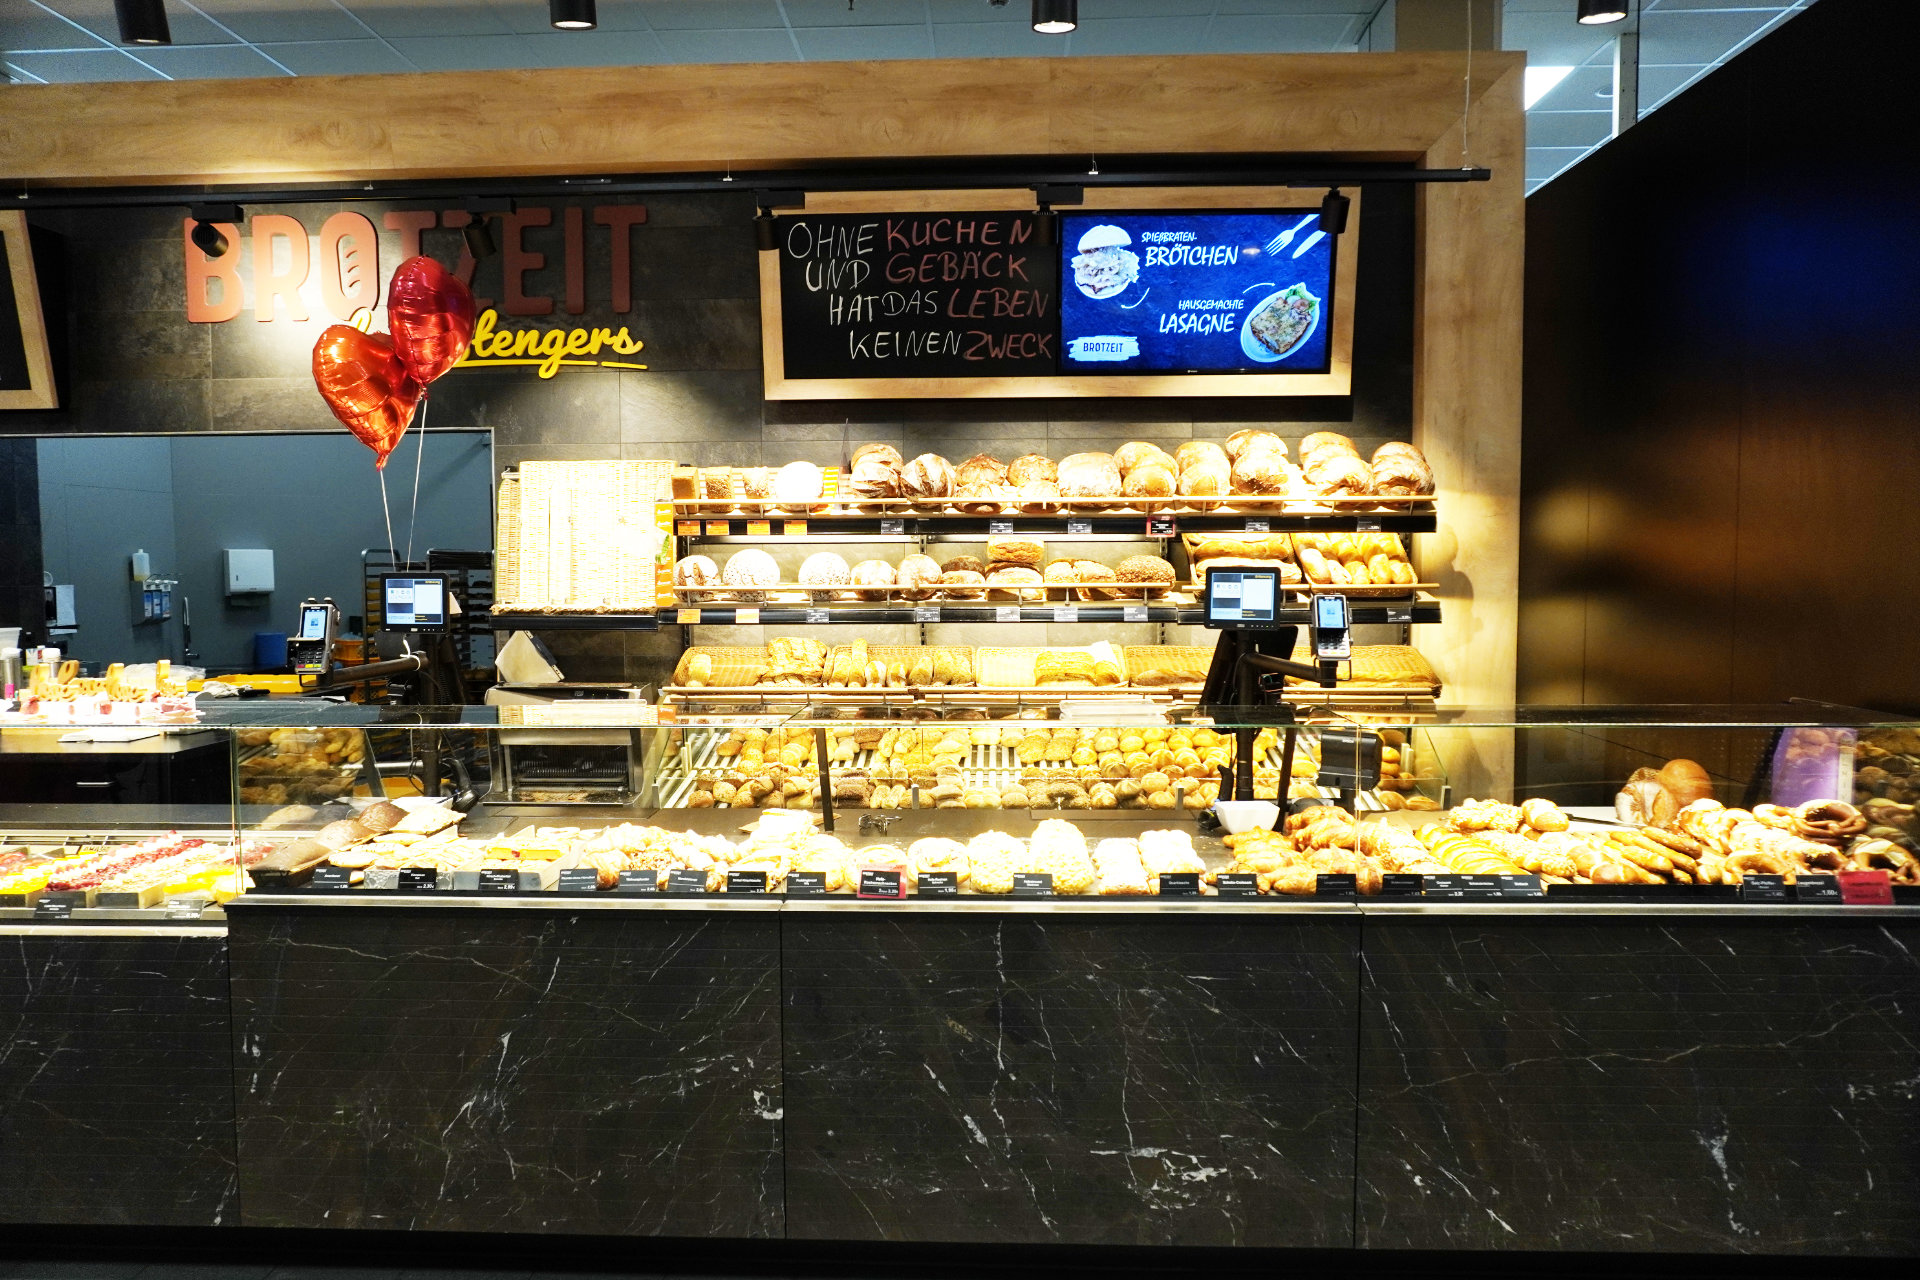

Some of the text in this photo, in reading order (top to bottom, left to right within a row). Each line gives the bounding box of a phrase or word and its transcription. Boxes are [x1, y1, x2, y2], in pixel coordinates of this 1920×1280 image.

[788, 218, 1032, 258] OHNE KUCHEN
[1145, 244, 1239, 267] BRÖTCHEN
[805, 251, 1029, 291] UND GEBÄCK
[829, 287, 1049, 325] HAT DAS LEBEN
[1178, 299, 1244, 310] HAUSGEMACHTE
[1159, 313, 1236, 335] LASAGNE
[461, 309, 644, 379] tengers
[849, 330, 1053, 360] KEINEN ZWECK
[1083, 342, 1124, 353] BROTZEIT
